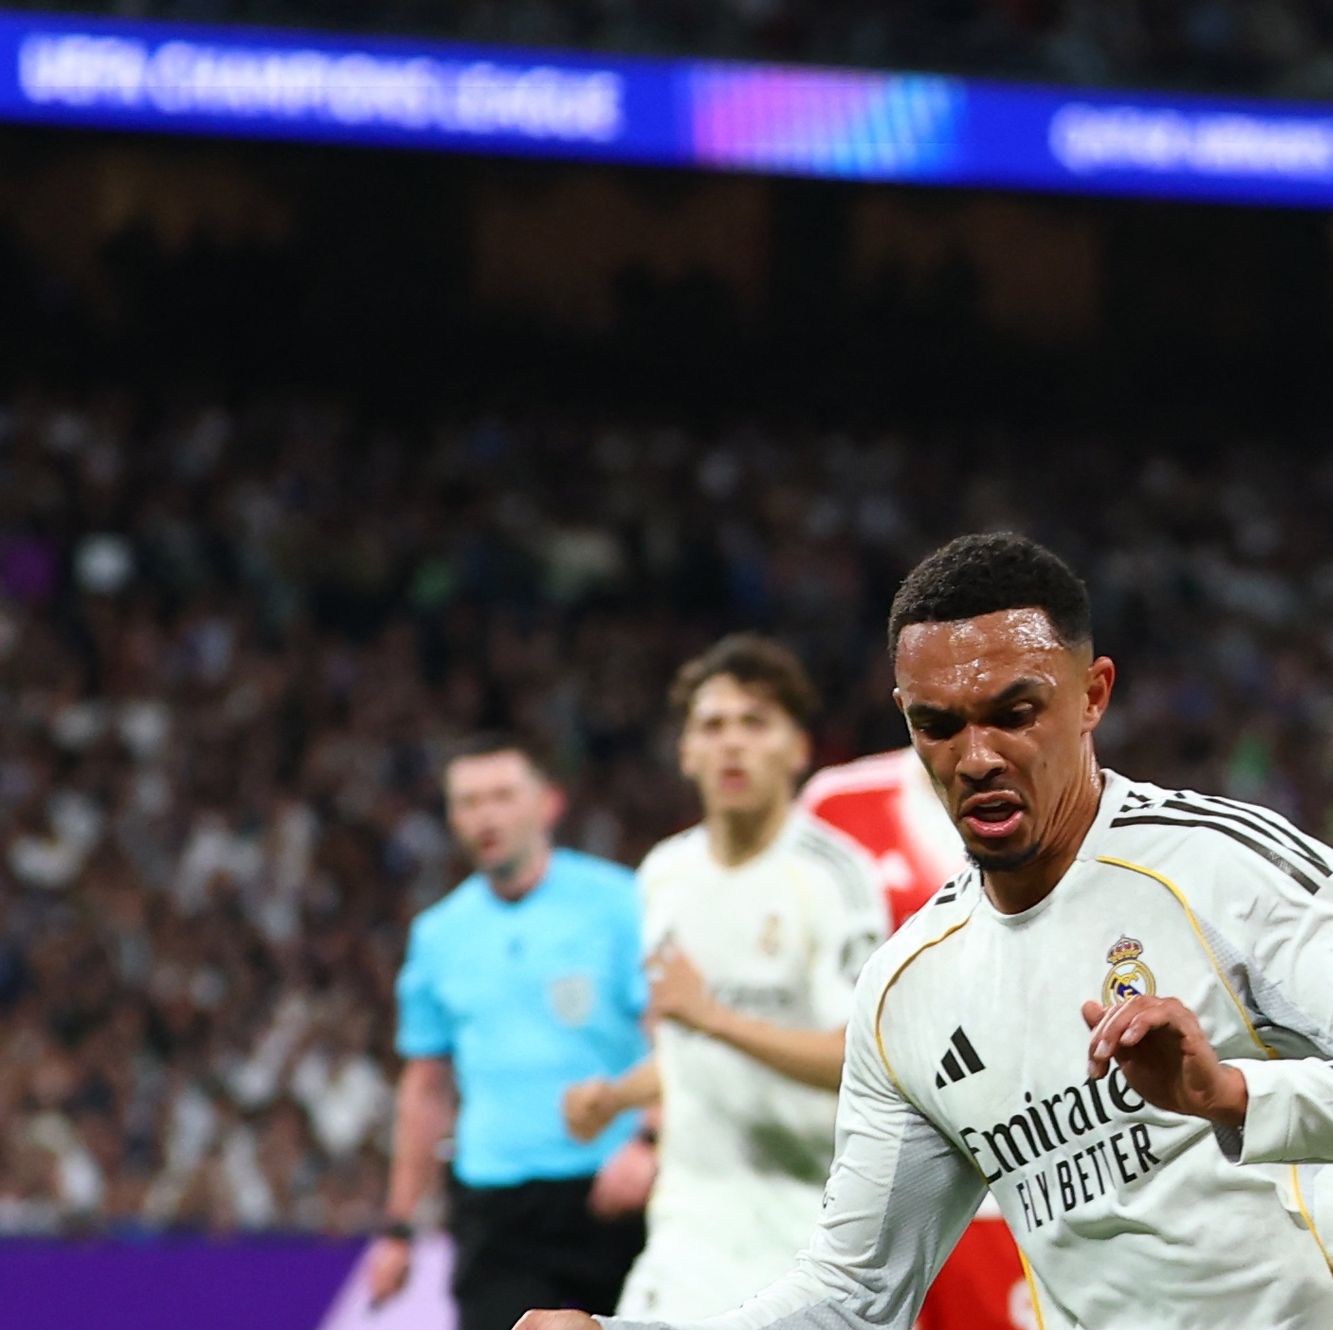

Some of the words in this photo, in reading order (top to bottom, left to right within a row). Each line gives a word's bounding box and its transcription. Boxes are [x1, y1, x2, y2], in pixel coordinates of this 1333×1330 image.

[958, 1066, 1146, 1184] Emirate
[1016, 1171, 1054, 1233] FLY
[1056, 1123, 1160, 1212] BETTER
